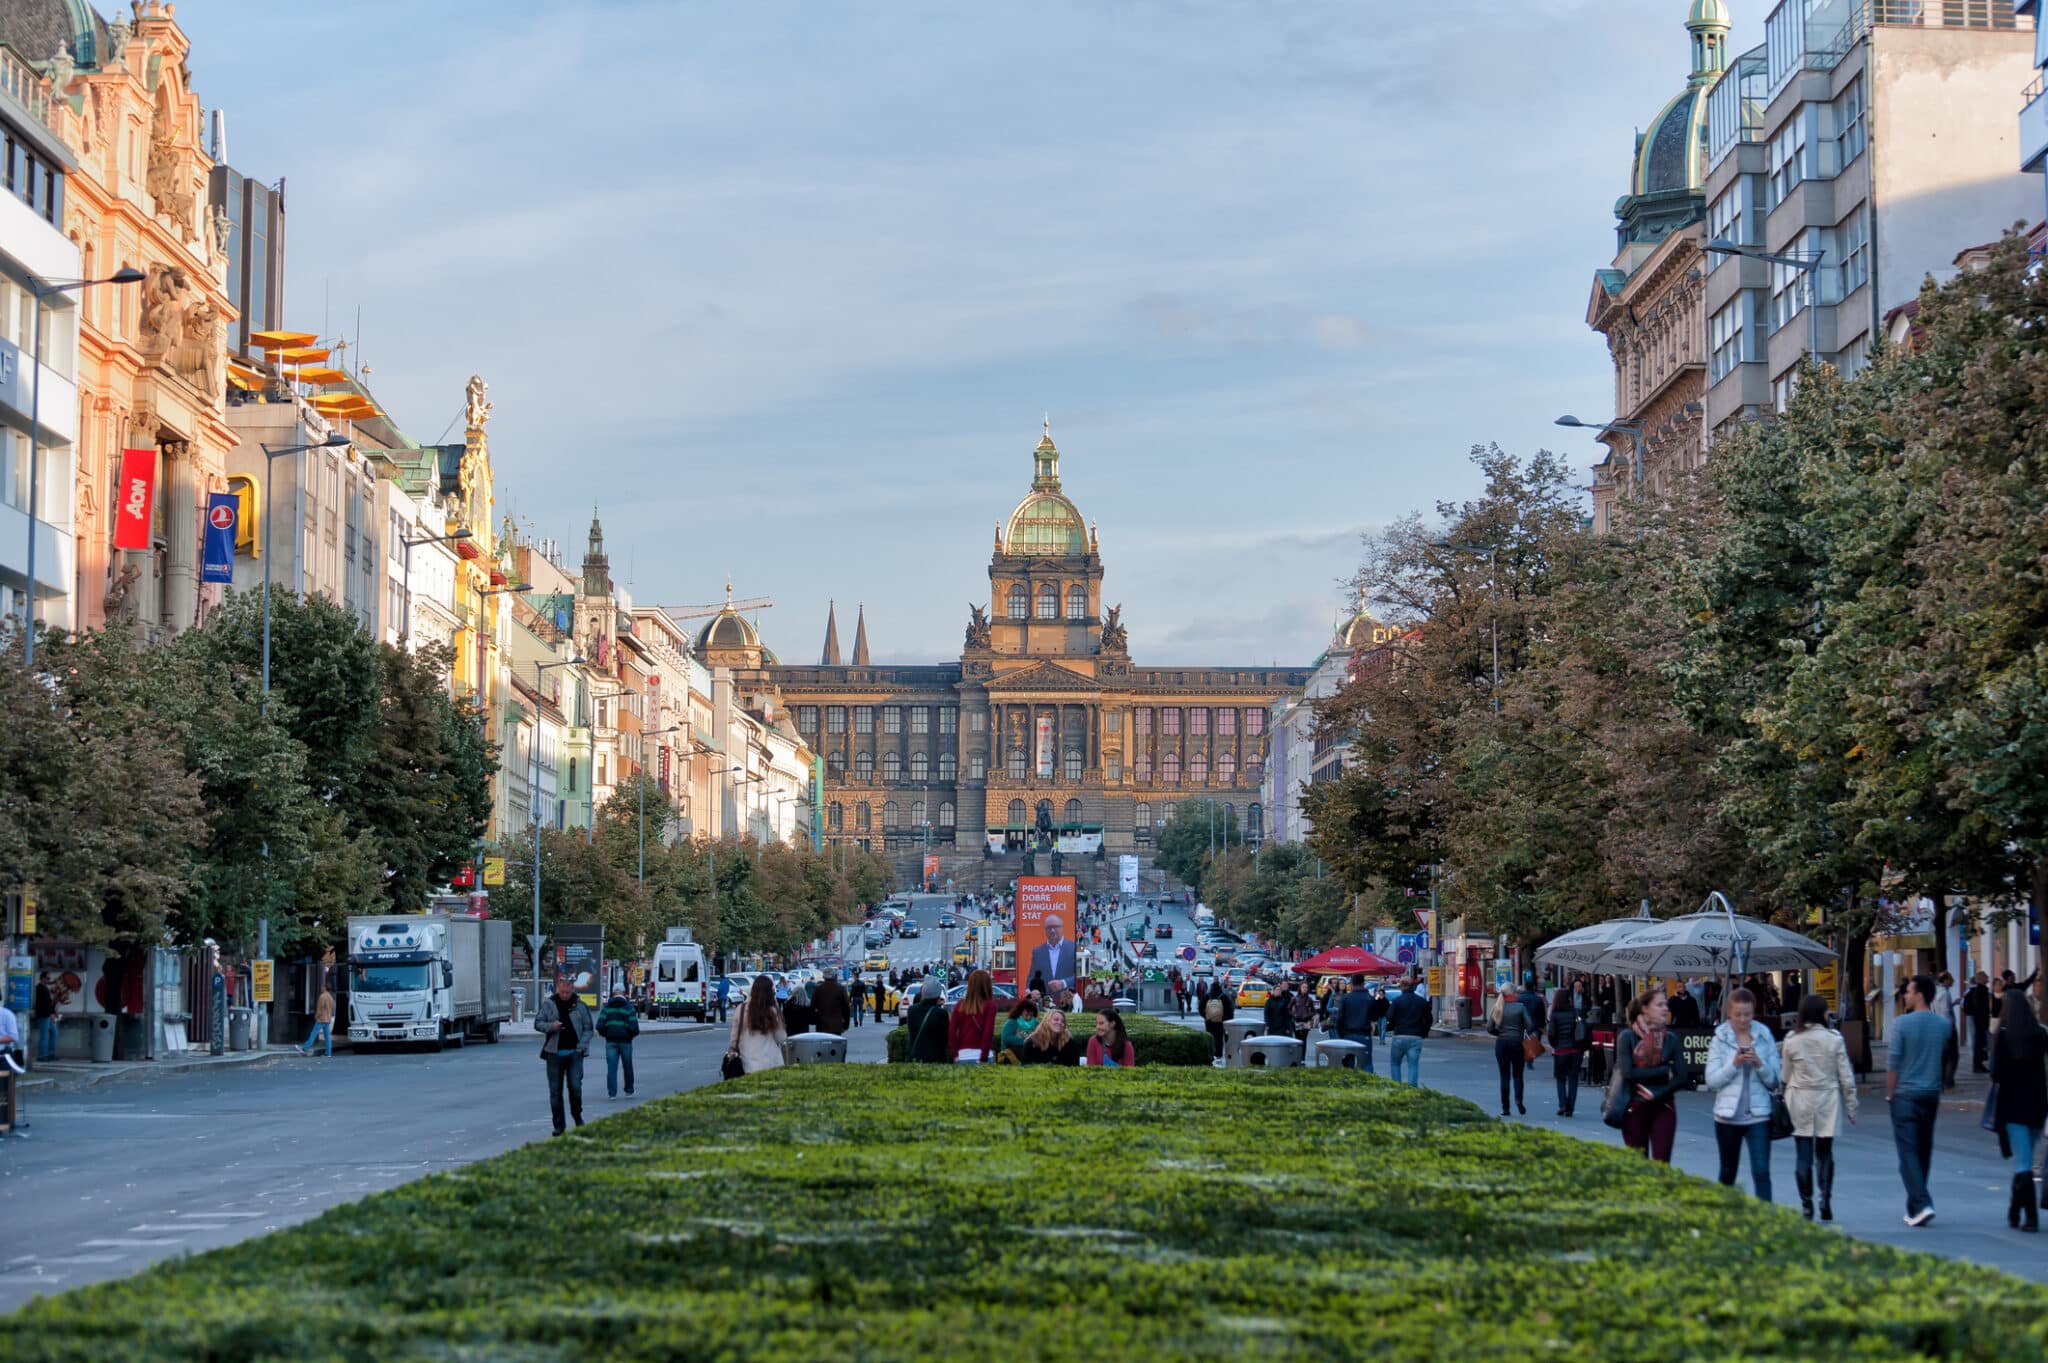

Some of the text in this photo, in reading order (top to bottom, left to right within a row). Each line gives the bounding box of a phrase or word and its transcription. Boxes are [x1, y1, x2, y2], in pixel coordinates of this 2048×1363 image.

[126, 478, 147, 520] AON
[1022, 884, 1072, 893] PROSADÍME
[1022, 893, 1051, 902] DOBŘE
[1022, 902, 1067, 911] FUNGUJÍCÍ
